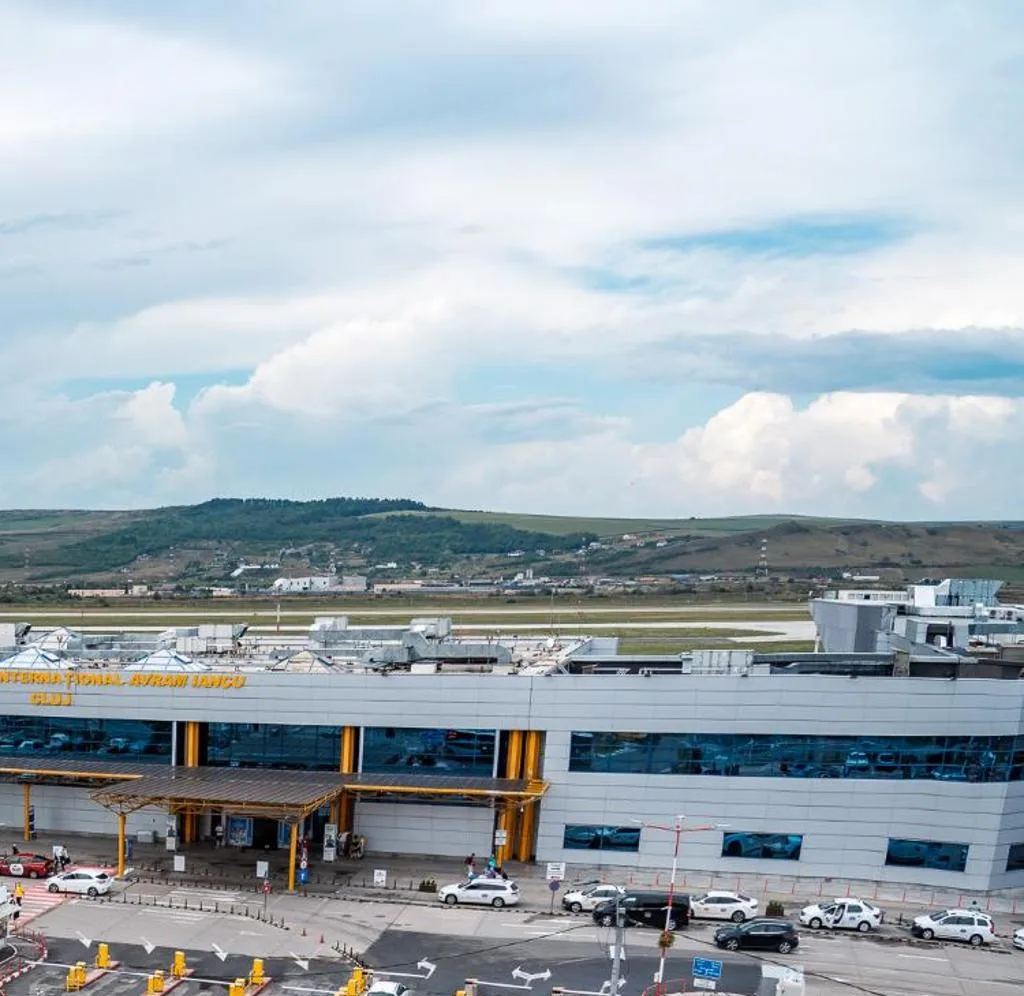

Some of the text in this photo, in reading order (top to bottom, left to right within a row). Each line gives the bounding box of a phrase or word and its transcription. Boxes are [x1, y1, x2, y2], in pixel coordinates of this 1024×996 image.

[127, 673, 189, 688] AVRAM
[191, 674, 246, 689] IANCU
[31, 692, 72, 706] CLUJ
